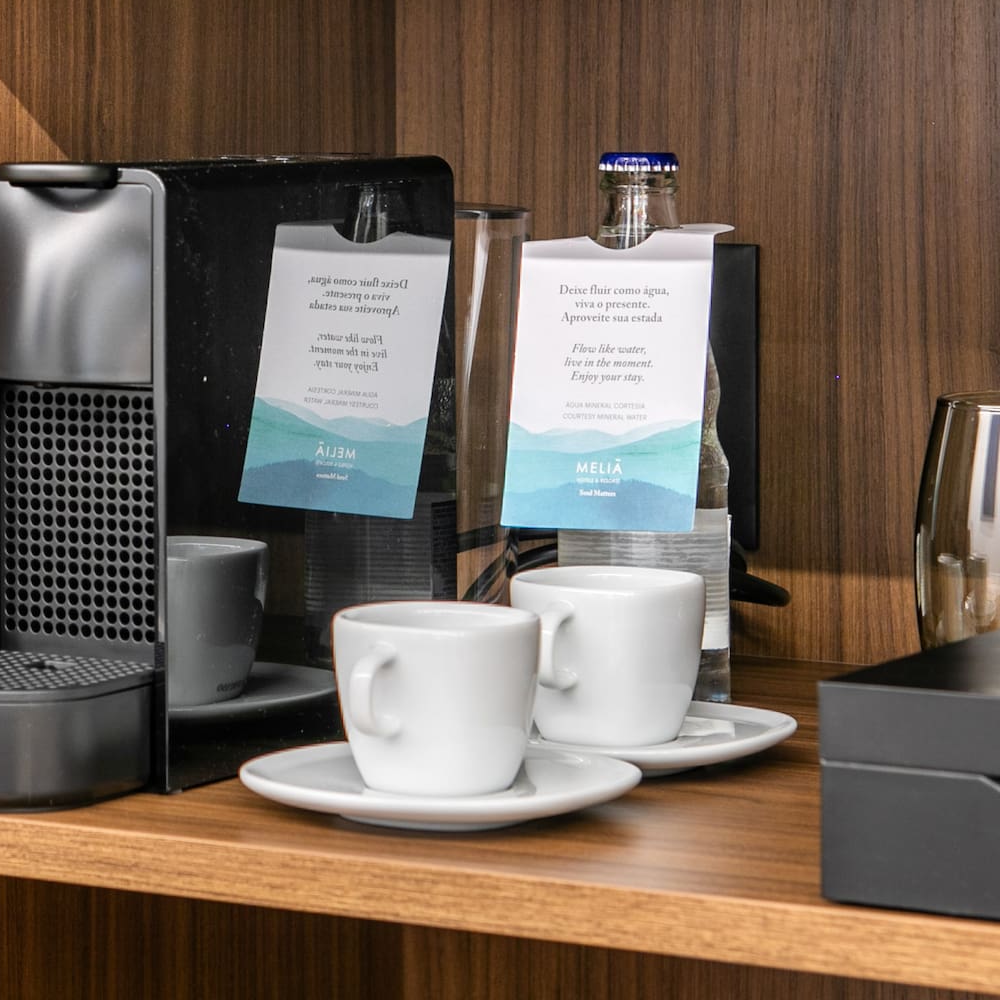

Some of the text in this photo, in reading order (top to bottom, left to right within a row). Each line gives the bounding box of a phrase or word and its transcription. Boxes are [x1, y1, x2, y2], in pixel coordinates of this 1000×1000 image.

[560, 284, 670, 298] Deixe fluir como água,
[575, 299, 651, 312] viva o presente.
[561, 311, 663, 325] Aproveite sua estada
[572, 343, 647, 355] Flow like water,
[564, 356, 653, 368] live in the moment.
[571, 370, 645, 385] Enjoy your stay.
